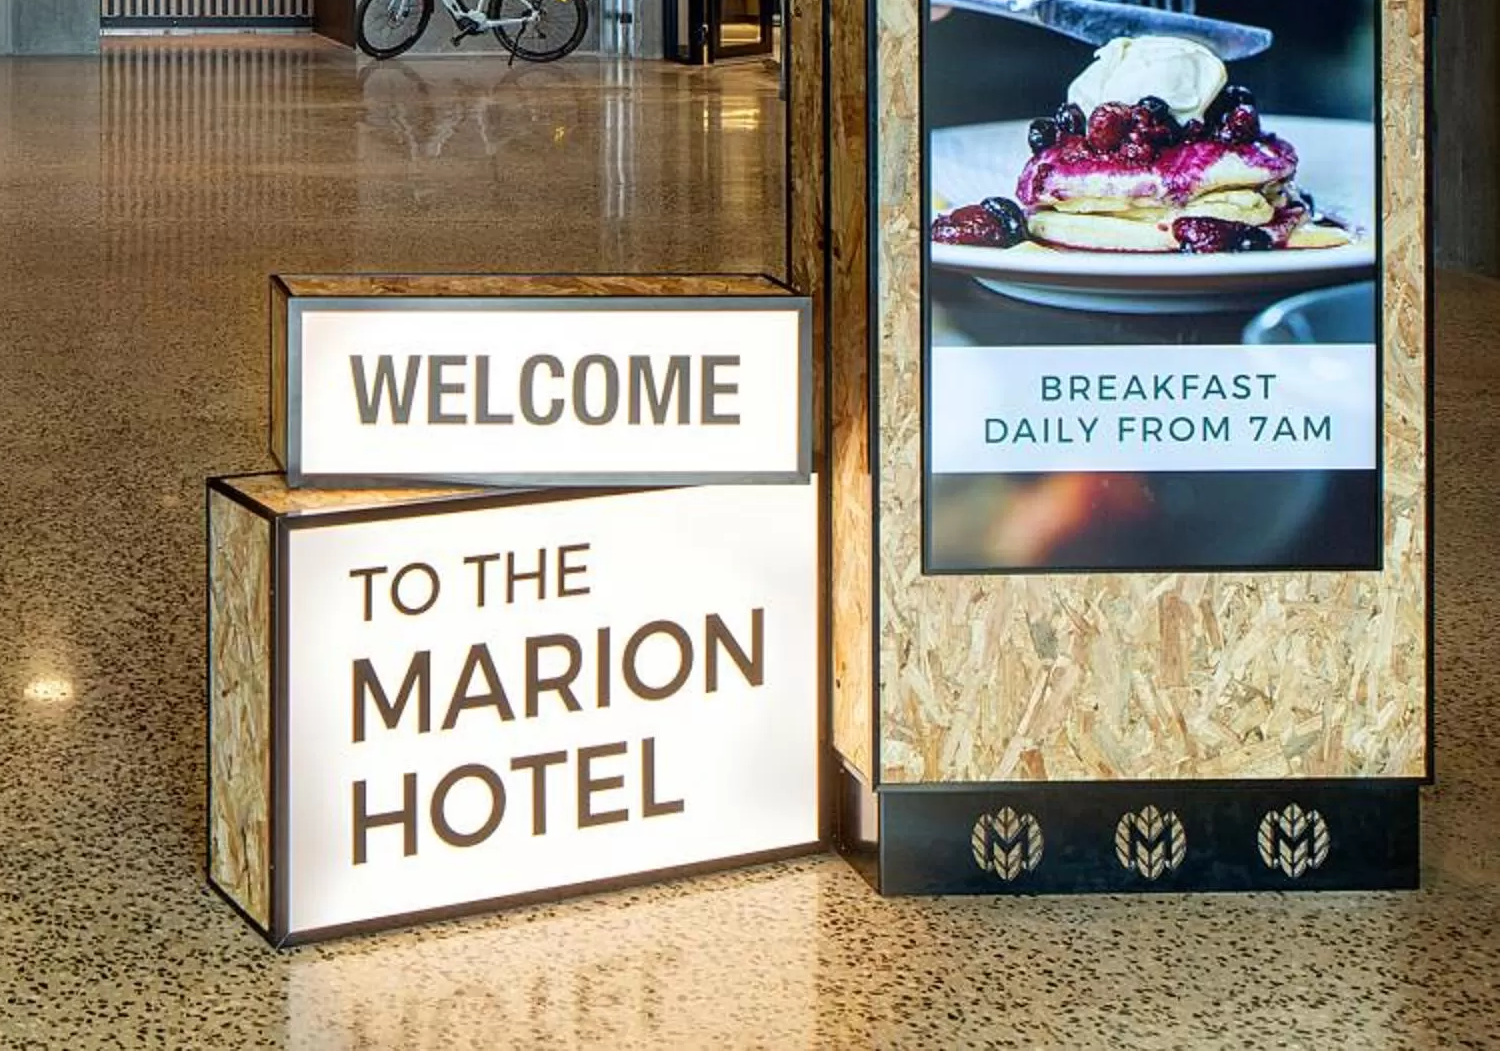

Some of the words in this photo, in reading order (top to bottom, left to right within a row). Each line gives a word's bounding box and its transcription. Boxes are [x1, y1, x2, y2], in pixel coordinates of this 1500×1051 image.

[349, 353, 741, 426] WELCOME
[1041, 374, 1277, 402] BREAKFAST
[984, 416, 1099, 444] DAILY
[1118, 416, 1230, 443] FROM
[1248, 415, 1332, 442] 7AM
[349, 562, 441, 622] TO
[463, 542, 591, 608] THE
[351, 607, 765, 744] MARION
[351, 736, 685, 866] HOTEL
